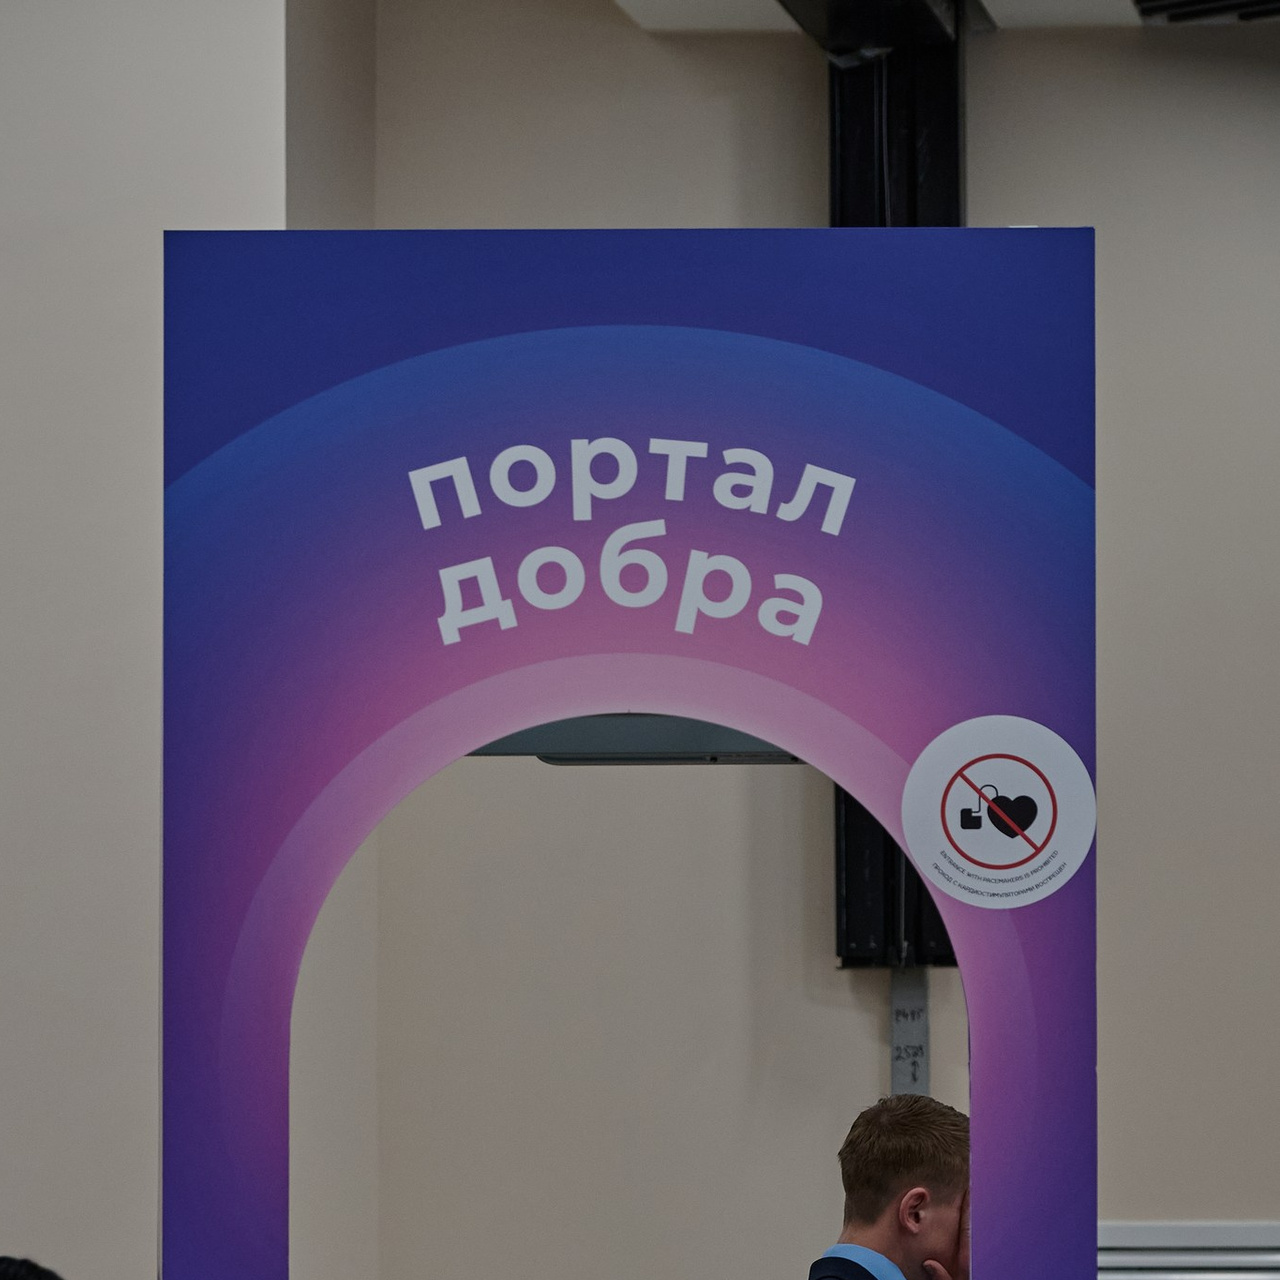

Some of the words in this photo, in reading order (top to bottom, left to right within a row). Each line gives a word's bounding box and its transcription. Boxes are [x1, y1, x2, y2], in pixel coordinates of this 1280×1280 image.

[409, 437, 856, 537] портал
[437, 519, 823, 646] добра
[940, 850, 966, 876] ENTRANCE
